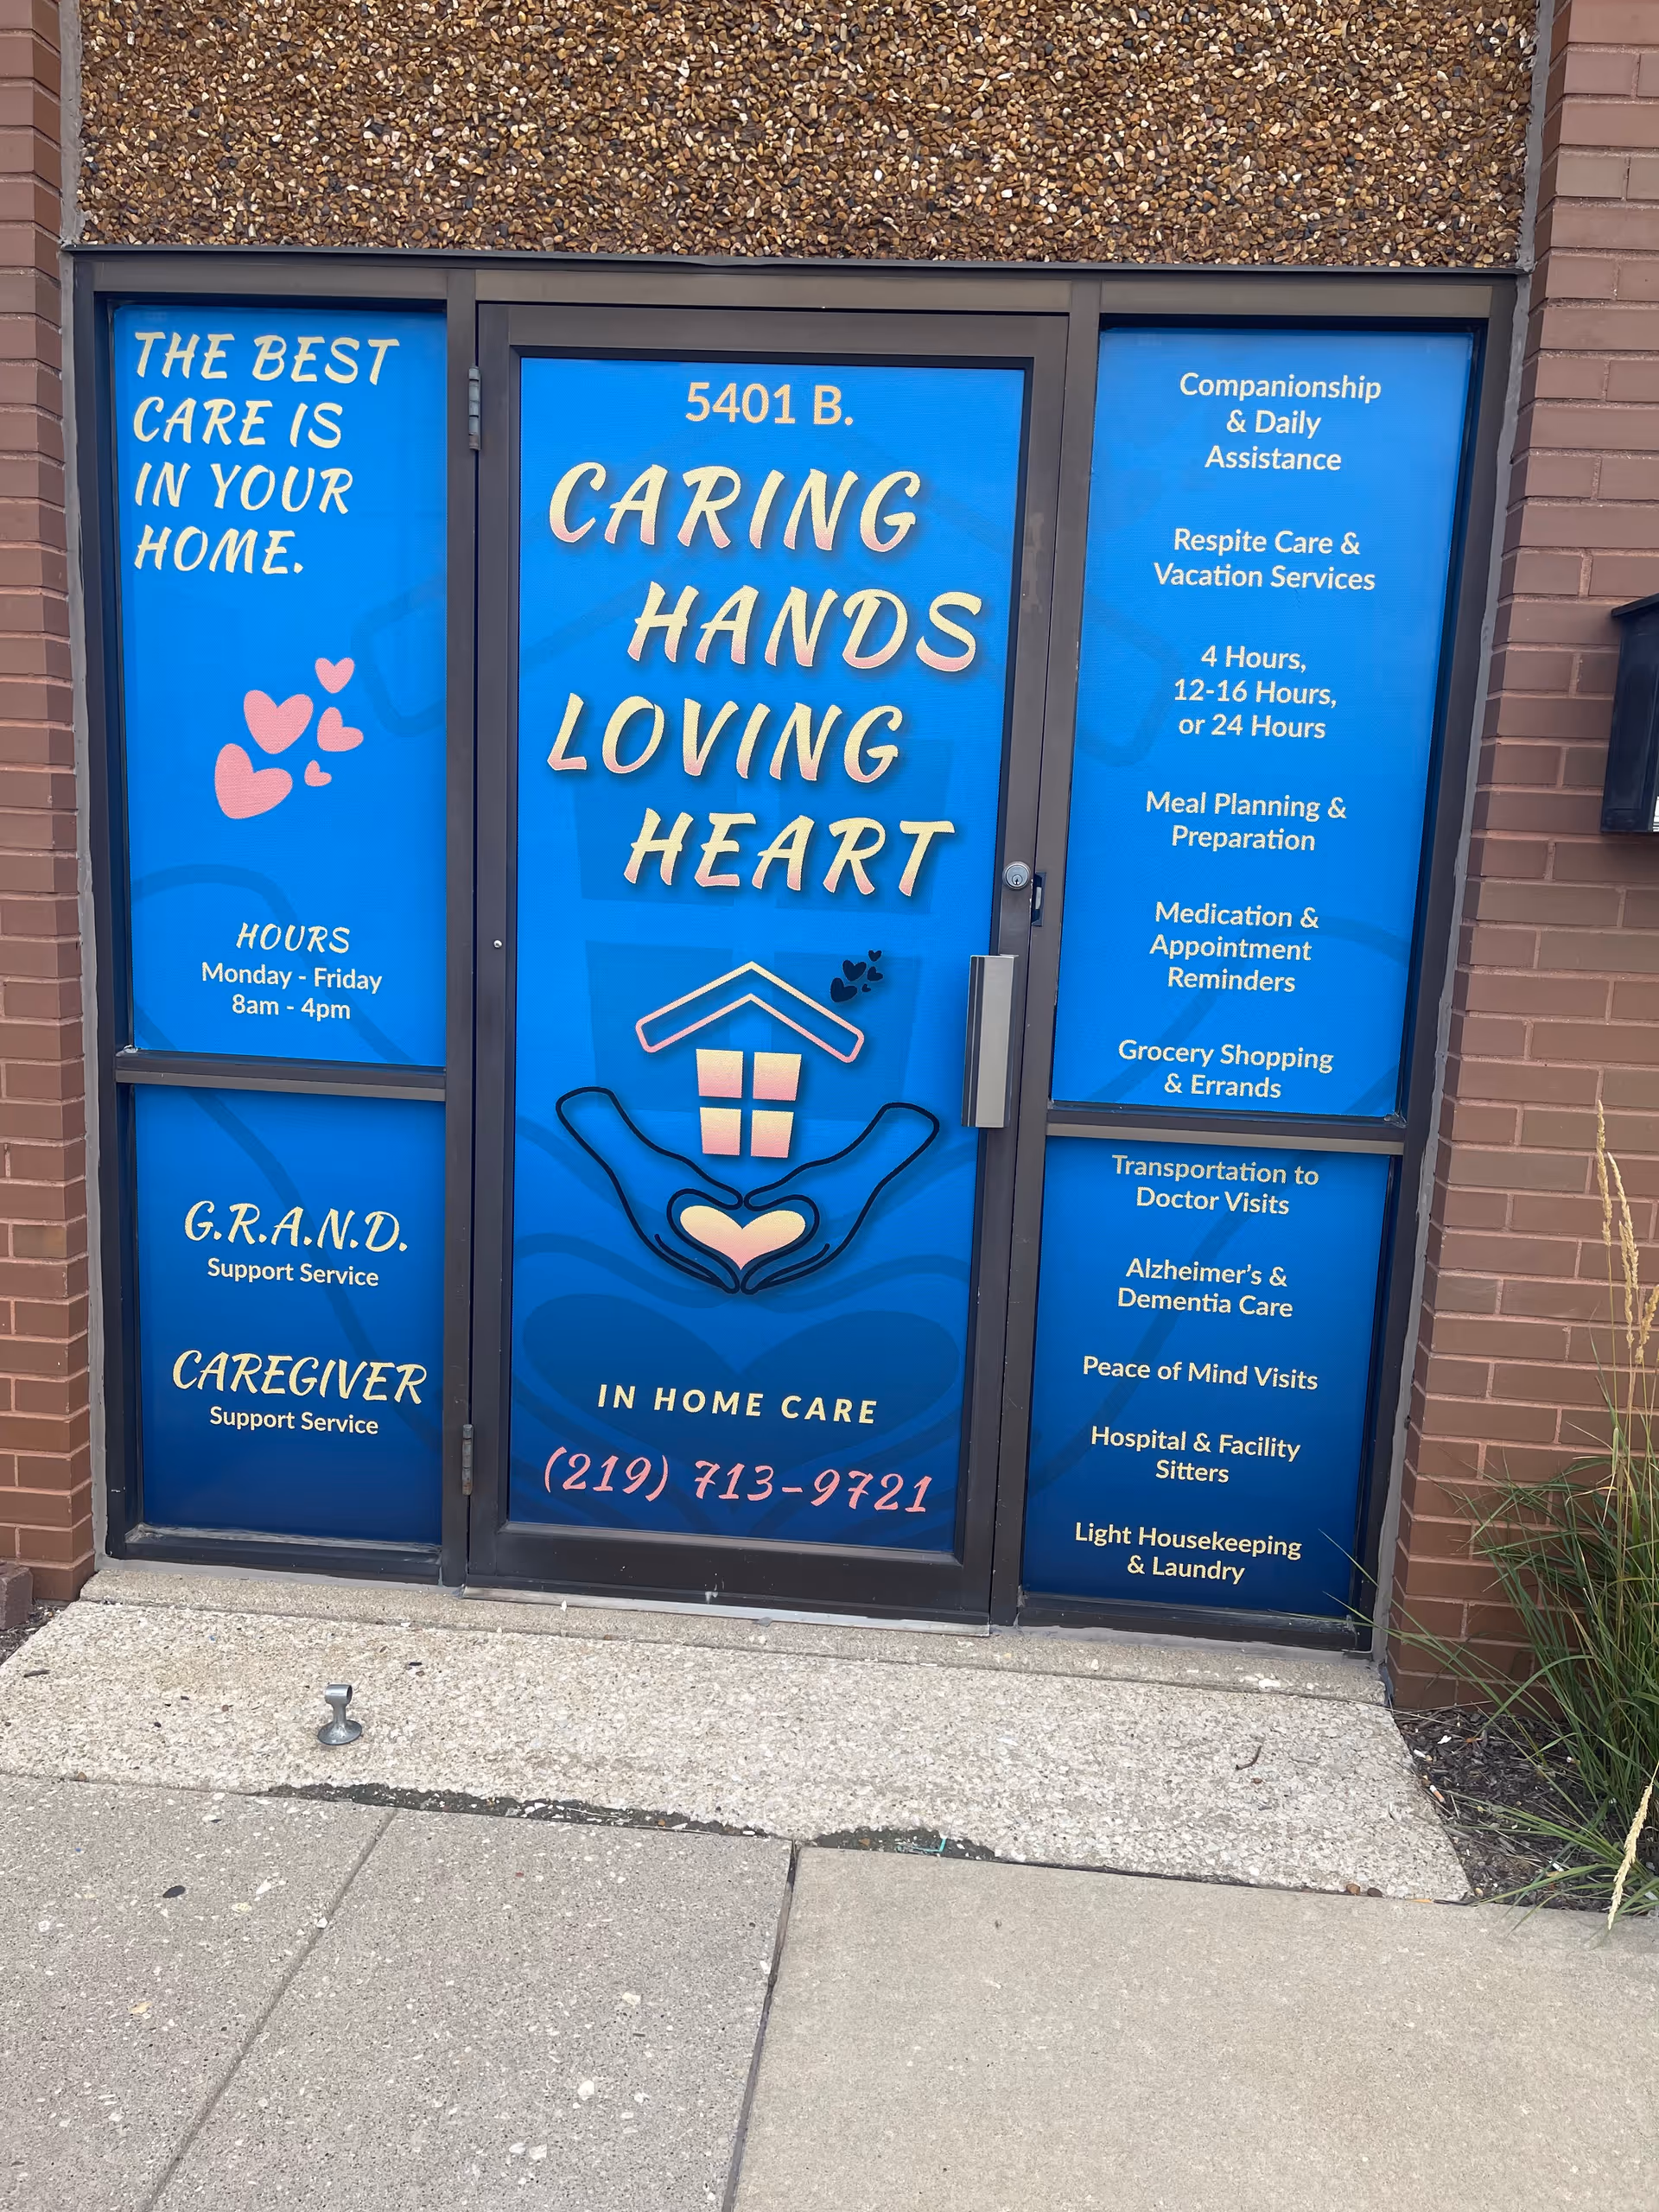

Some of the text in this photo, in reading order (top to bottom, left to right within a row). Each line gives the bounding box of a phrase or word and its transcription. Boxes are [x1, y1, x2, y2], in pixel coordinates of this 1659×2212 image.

[136, 332, 399, 385] THE BEST
[1180, 372, 1381, 404] Companionship
[686, 382, 853, 425] 5401 B.
[134, 397, 342, 448] CARE IS
[1227, 410, 1321, 439] & Daily
[1205, 445, 1341, 470] Assistance
[136, 462, 353, 514] IN YOUR
[550, 462, 920, 552] CARING
[135, 524, 303, 574] HOME.
[1174, 528, 1360, 556] Respite Care &
[1154, 563, 1375, 590] Vacation Services
[627, 582, 982, 671] HANDS
[1201, 645, 1306, 672] 4 Hours,
[1175, 679, 1336, 708] 12-16 Hours,
[547, 693, 902, 783] LOVING
[1179, 714, 1325, 738] or 24 Hours
[1147, 791, 1346, 822] Meal Planning &
[624, 808, 955, 896] HEART
[1173, 825, 1314, 851] Preparation
[1156, 902, 1319, 928] Medication &
[237, 923, 349, 953] HOURS
[1150, 934, 1312, 960] Appointment
[202, 963, 292, 989] Monday
[315, 968, 382, 994] Friday
[1168, 967, 1294, 992] Reminders
[232, 994, 278, 1014] 8am
[302, 998, 350, 1021] 4pm
[1119, 1039, 1333, 1073] Grocery Shopping
[1165, 1073, 1281, 1097] & Errands
[1112, 1155, 1319, 1185] Transportation to
[1137, 1187, 1288, 1214] Doctor Visits
[185, 1201, 407, 1252] G.R.A.N.D.
[208, 1258, 378, 1286] Support Service
[1126, 1258, 1287, 1287] Alzheimer's &
[1118, 1287, 1293, 1317] Dementia Care
[173, 1351, 426, 1404] CAREGIVER
[1084, 1356, 1318, 1389] Peace of Mind Visits
[599, 1384, 876, 1423] IN HOME CARE
[210, 1407, 378, 1434] Support Service
[1092, 1426, 1300, 1462] Hospital & Facility
[545, 1446, 931, 1512] (219) 713-9721
[1156, 1460, 1229, 1483] Sitters
[1076, 1522, 1301, 1560] Light Housekeeping
[1128, 1555, 1245, 1584] & Laundry
